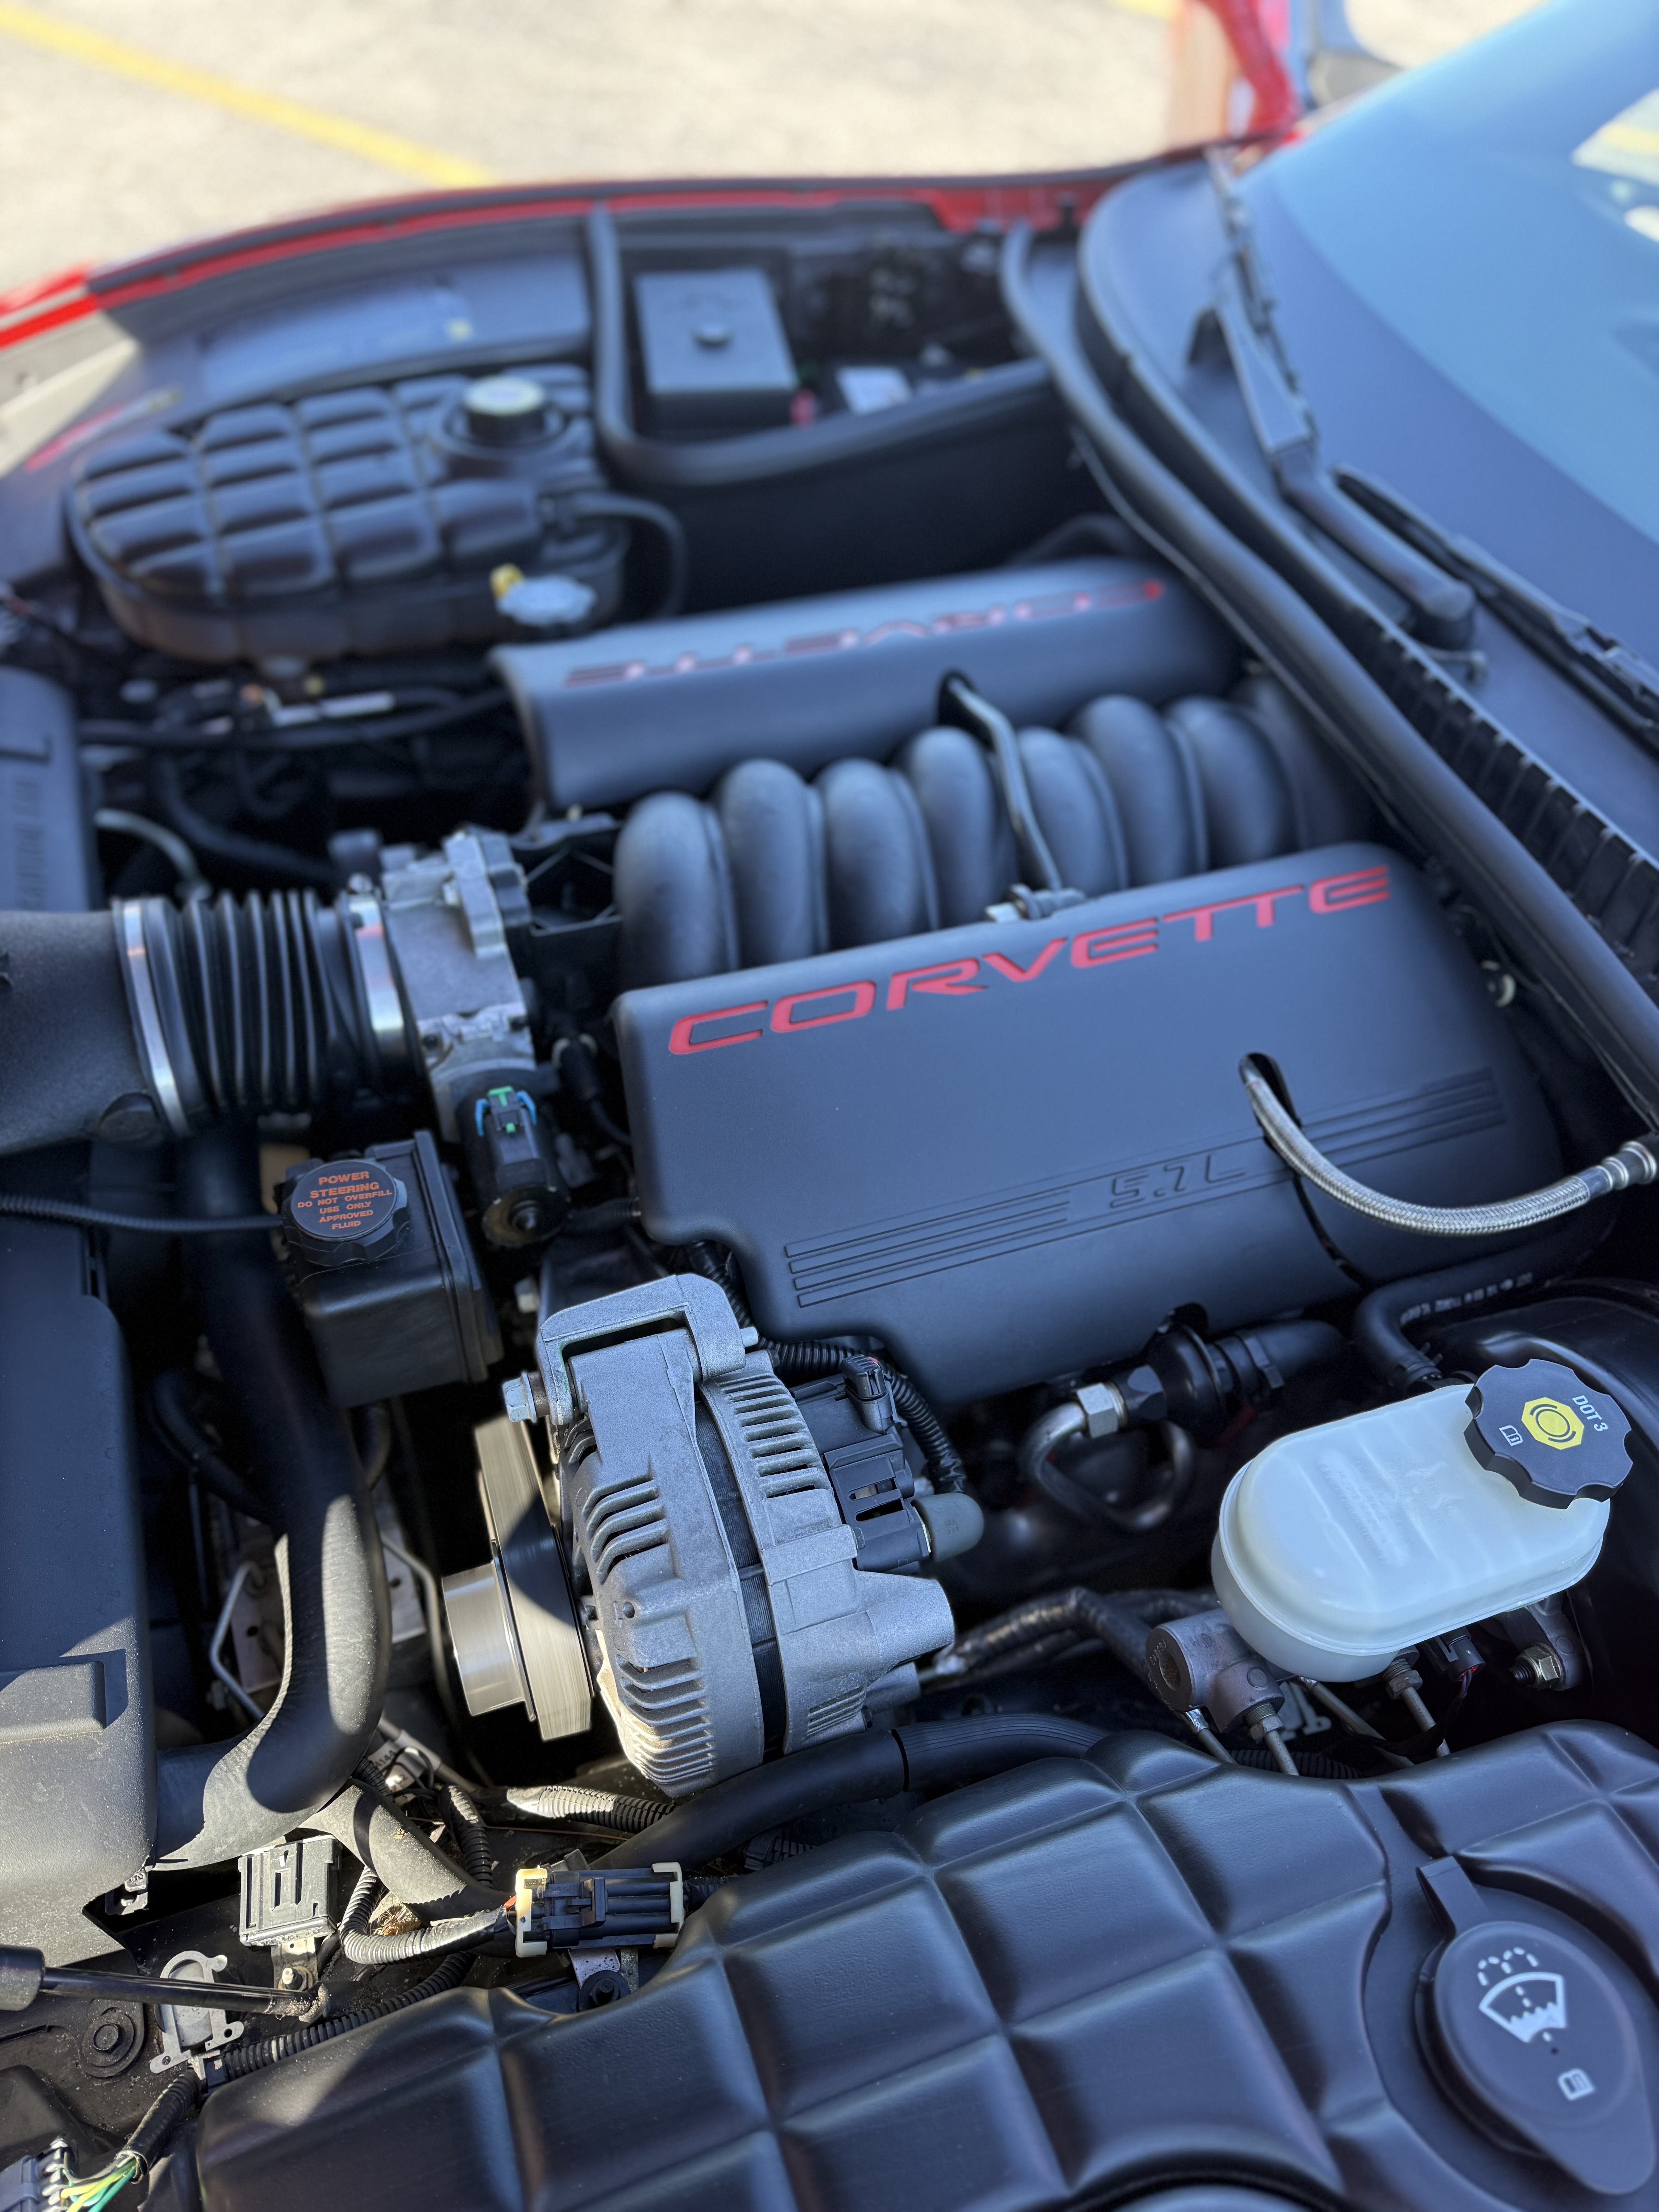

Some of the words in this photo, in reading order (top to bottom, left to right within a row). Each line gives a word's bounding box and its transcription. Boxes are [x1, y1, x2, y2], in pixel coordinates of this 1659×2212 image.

[668, 865, 1390, 1054] CORVETTE
[318, 1171, 369, 1185] POWER
[1109, 1154, 1246, 1209] 5.7L
[310, 1182, 380, 1199] STEERING
[318, 1197, 338, 1206] NOT
[345, 1189, 392, 1202] OVERFILL
[319, 1206, 340, 1214] USE
[346, 1201, 372, 1210] ONLY
[319, 1210, 374, 1223] APPROVED
[332, 1220, 361, 1230] FLUID
[1572, 1395, 1602, 1420] DOT
[1593, 1422, 1609, 1432] 3
